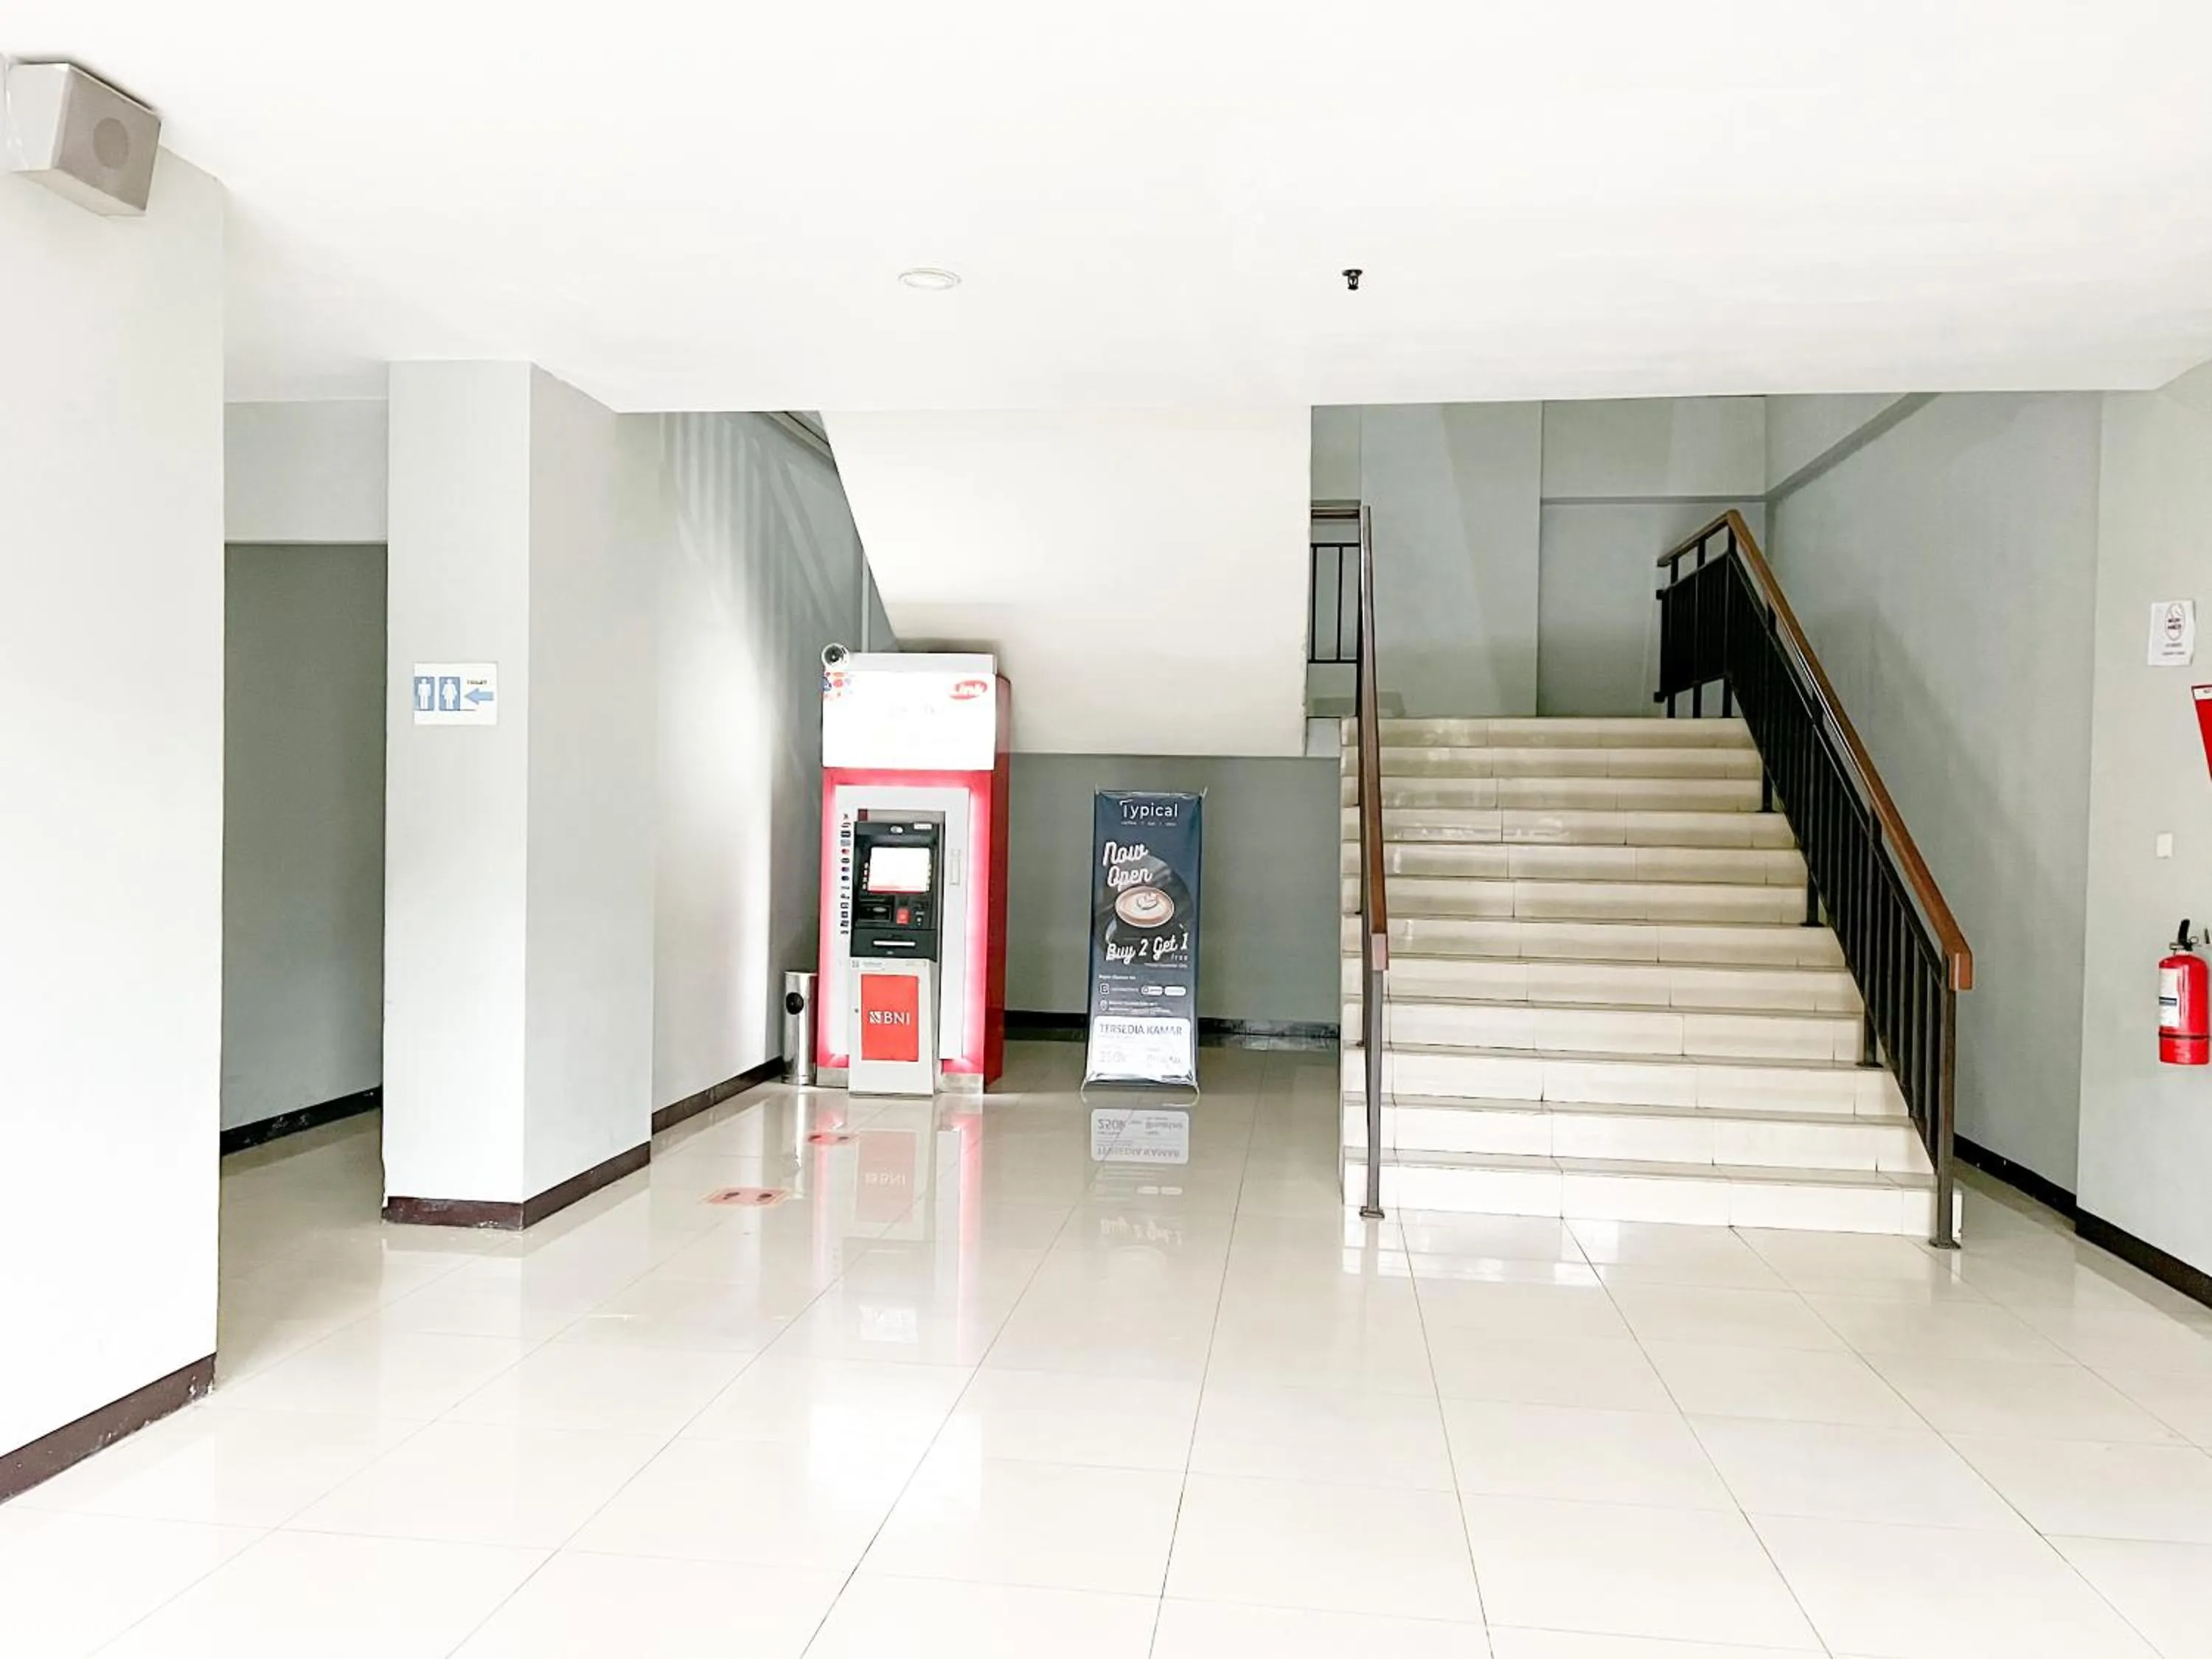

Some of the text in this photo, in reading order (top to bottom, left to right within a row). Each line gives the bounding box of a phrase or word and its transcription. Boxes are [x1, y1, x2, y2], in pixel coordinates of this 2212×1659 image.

[1119, 799, 1178, 819] Typical
[1102, 841, 1148, 866] Now
[1107, 866, 1152, 891] Open
[1106, 932, 1189, 964] Buy 2 Get 1
[883, 1011, 911, 1025] BNI
[1100, 1023, 1145, 1034] TERSEDIA
[1147, 1026, 1183, 1036] KAMAR
